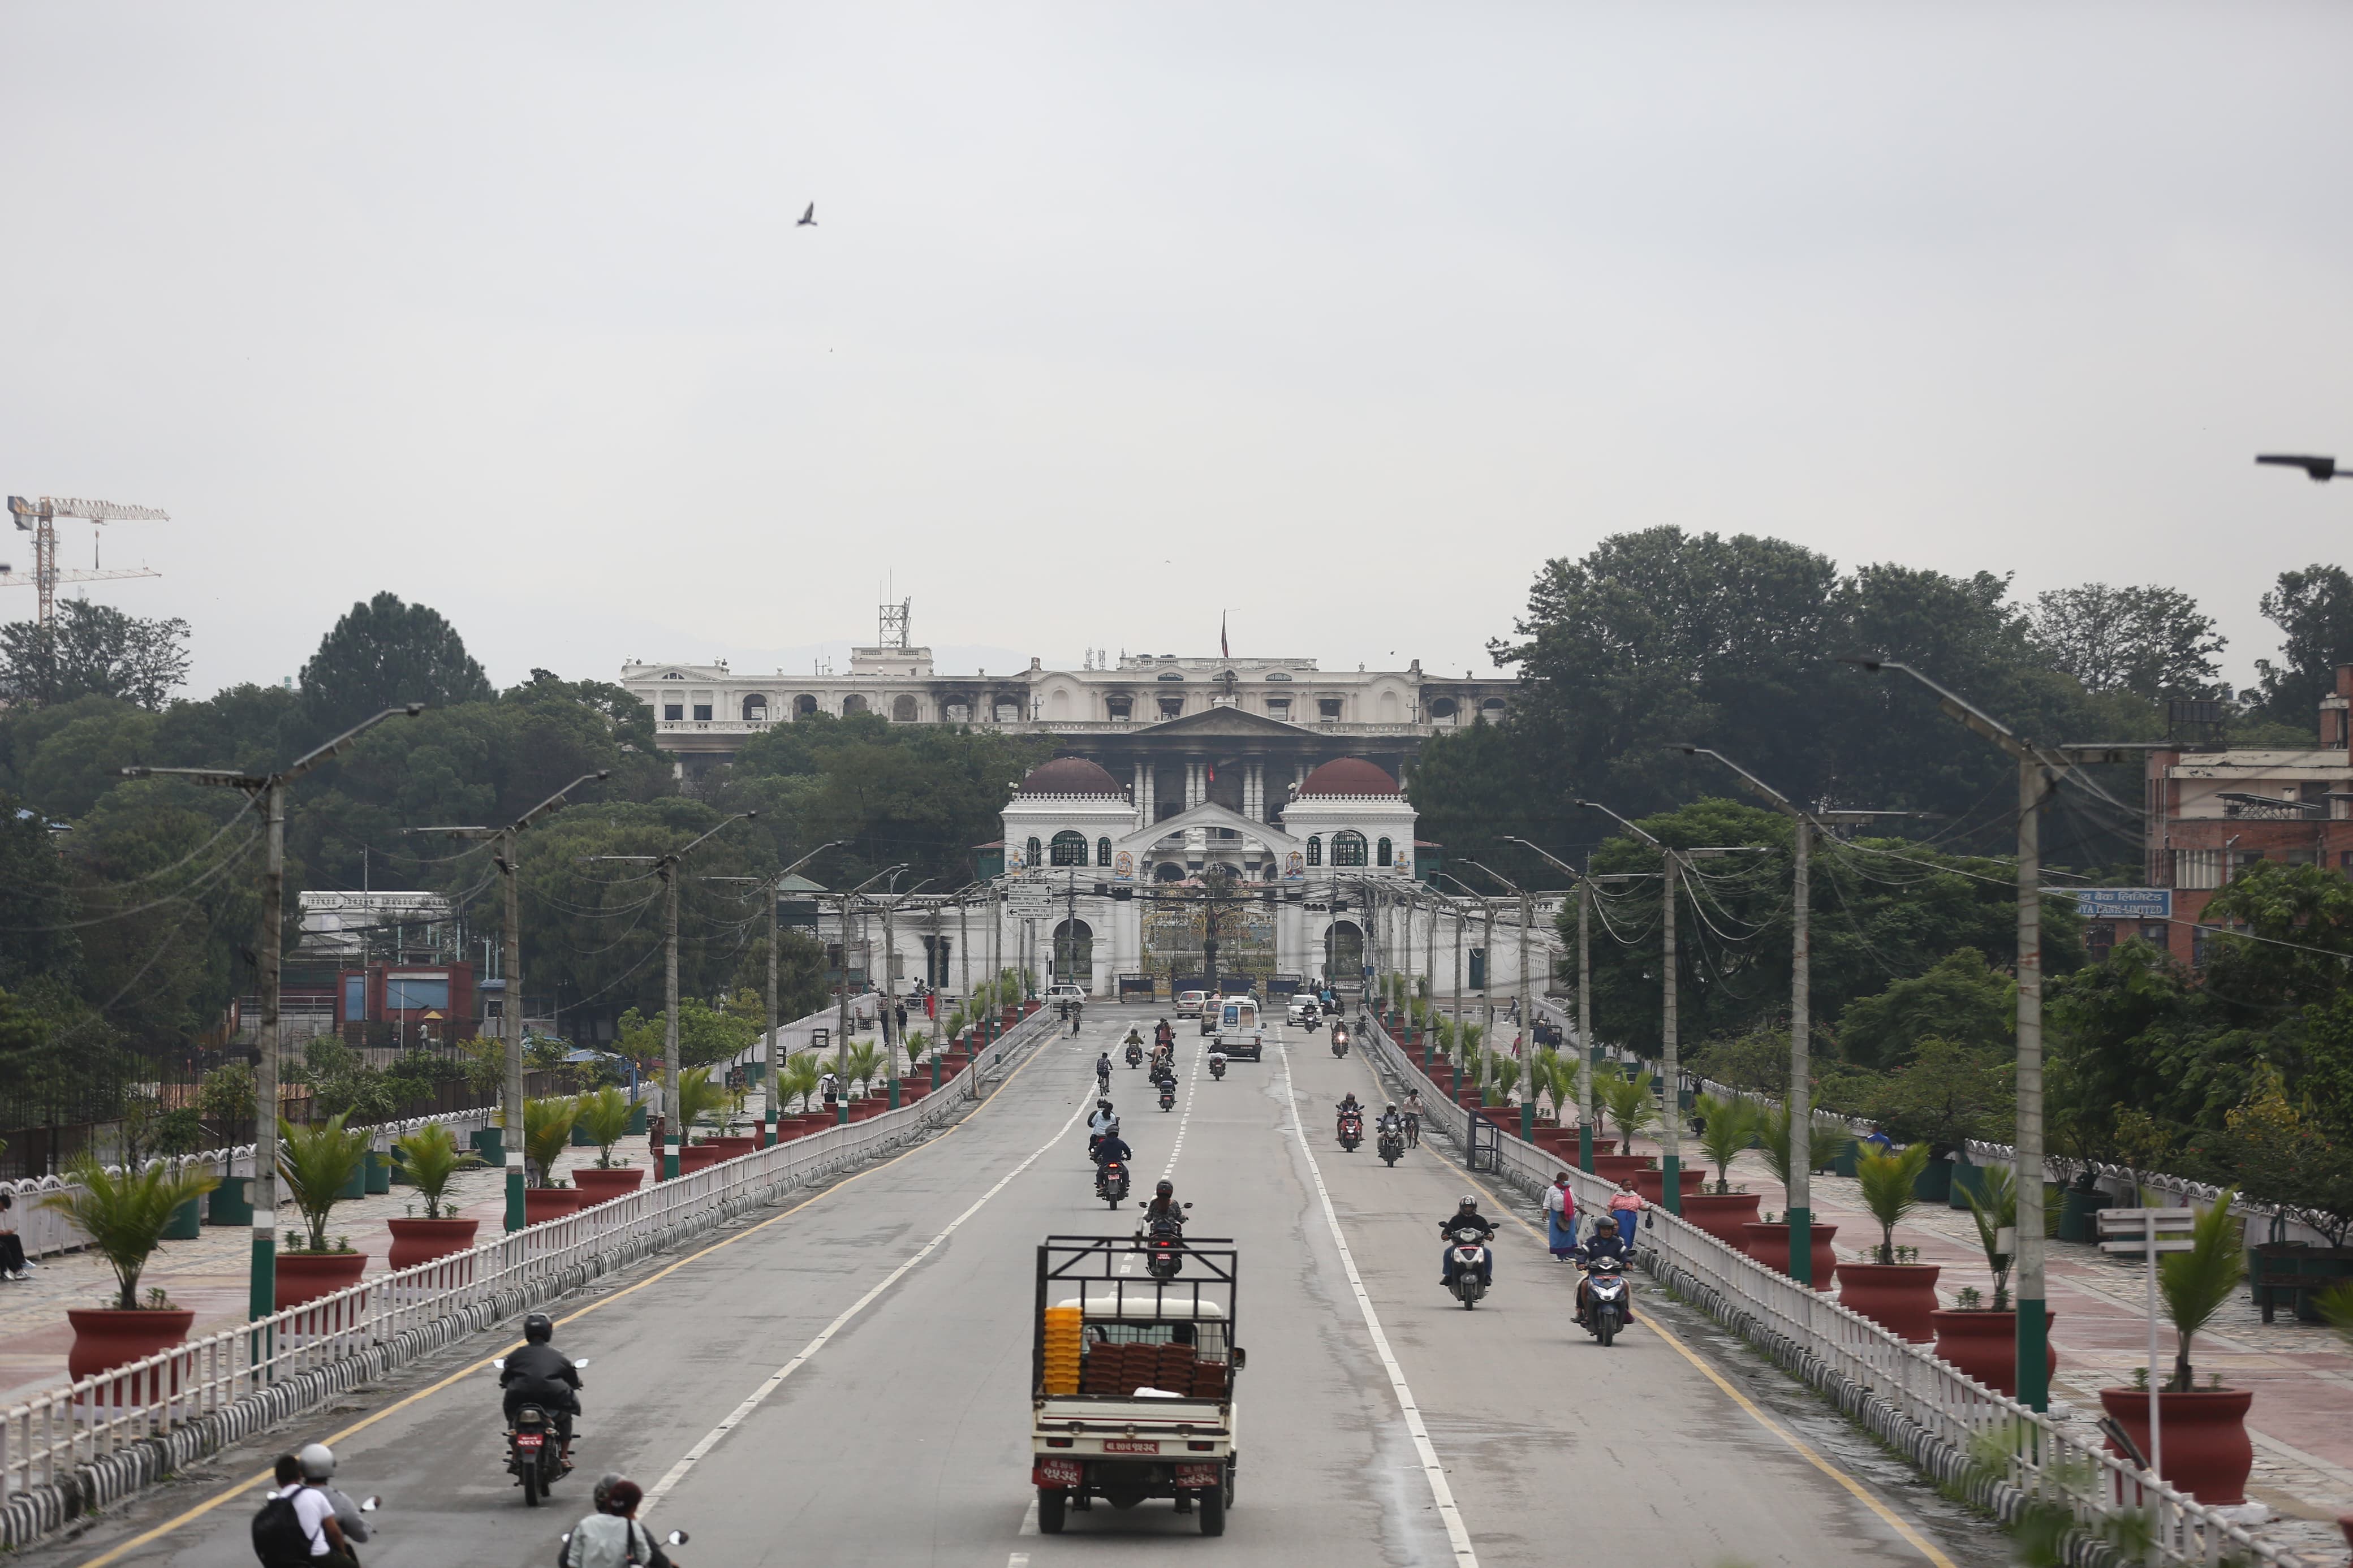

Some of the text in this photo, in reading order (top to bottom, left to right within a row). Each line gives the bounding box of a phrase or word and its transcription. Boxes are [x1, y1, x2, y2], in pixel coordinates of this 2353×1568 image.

[2118, 892, 2163, 901] लिमिटेड
[2096, 904, 2122, 914] BANK
[2124, 905, 2163, 914] LIMITED
